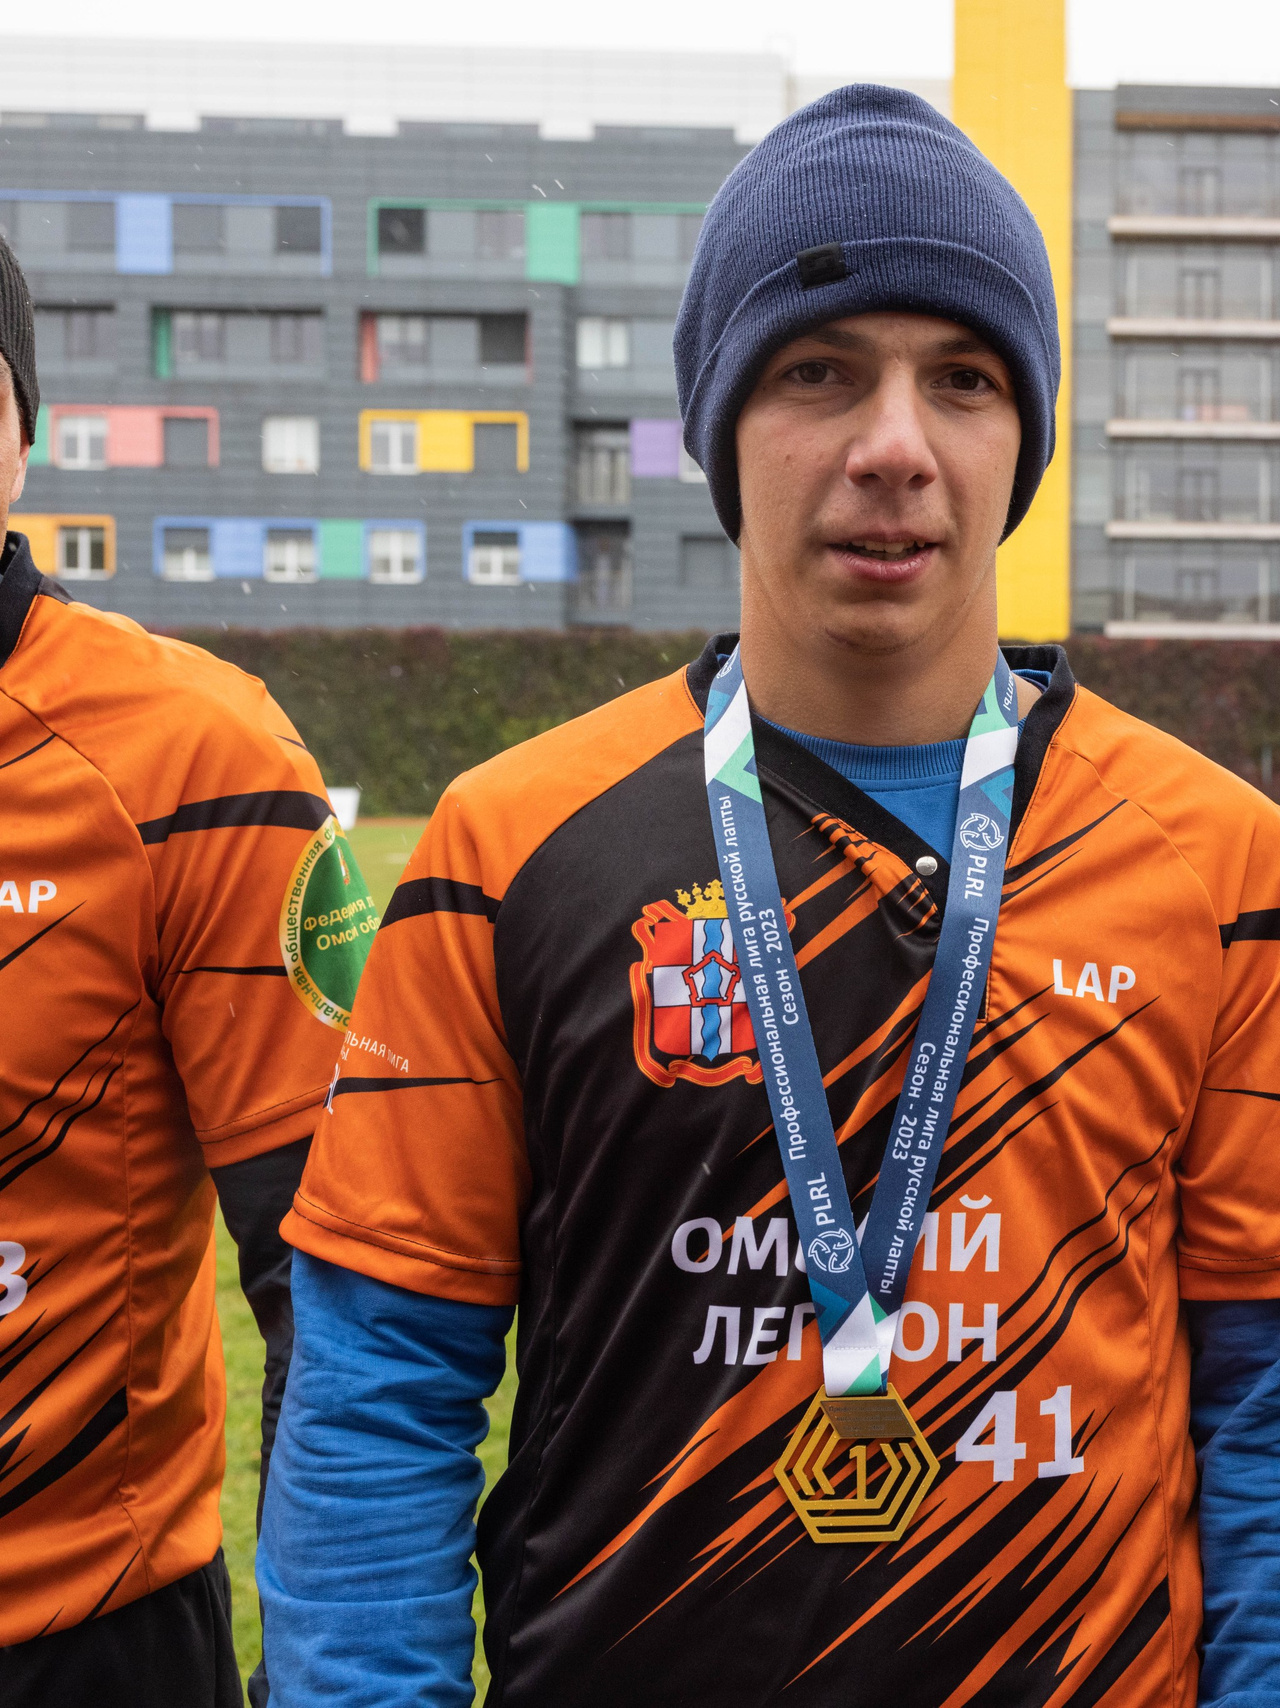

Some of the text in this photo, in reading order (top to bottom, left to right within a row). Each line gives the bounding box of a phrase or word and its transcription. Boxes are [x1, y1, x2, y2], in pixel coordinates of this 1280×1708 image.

[0, 879, 58, 914] AP
[285, 840, 324, 963] общественная
[964, 854, 988, 901] PLRL
[758, 908, 783, 954] 2023
[293, 965, 351, 1027] ональная
[718, 795, 807, 1160] Профессиональная лига русской лапты
[776, 969, 799, 1025] Сезон
[1051, 958, 1137, 1004] LAP
[907, 1041, 936, 1099] Сезон
[879, 916, 990, 1294] Профессиональная лига русской лапты
[892, 1111, 918, 1161] 2023
[806, 1172, 836, 1226] PLRL
[691, 1302, 999, 1366] ЛЕГОН
[954, 1384, 1085, 1483] 41
